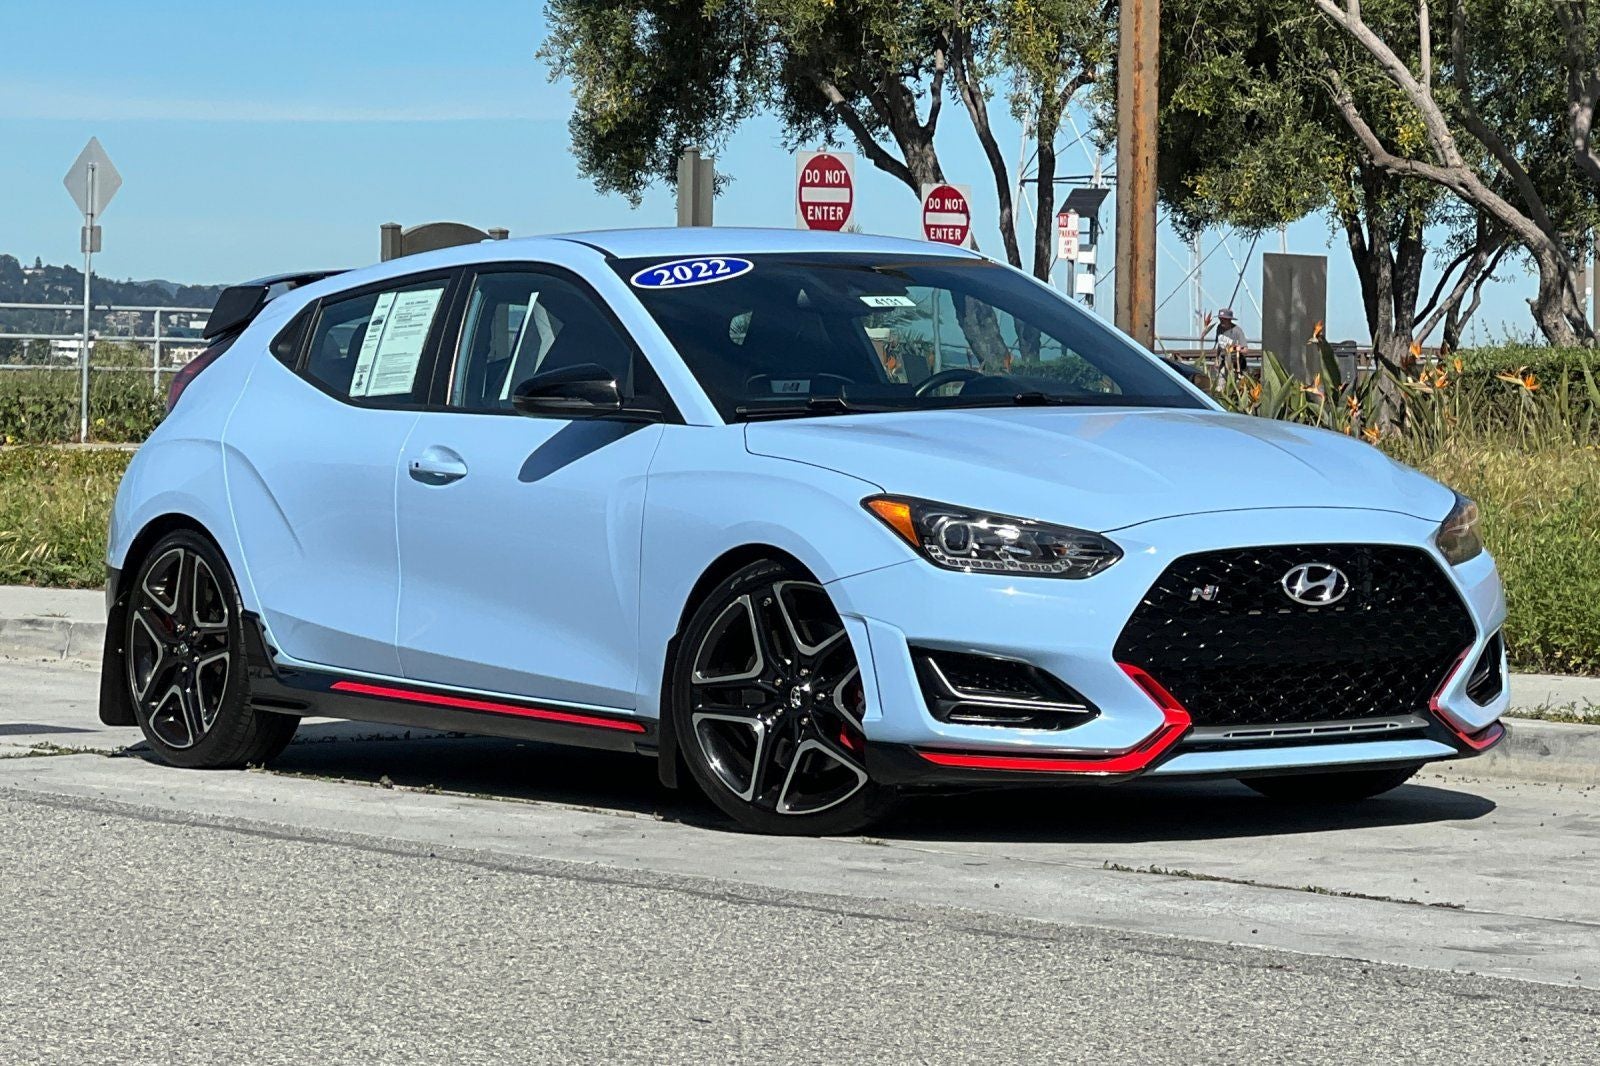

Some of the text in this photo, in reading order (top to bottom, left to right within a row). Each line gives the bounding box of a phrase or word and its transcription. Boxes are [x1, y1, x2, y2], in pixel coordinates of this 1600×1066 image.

[805, 169, 847, 184] DO NOT
[928, 198, 964, 211] DO NOT
[807, 206, 844, 221] ENTER
[1059, 215, 1068, 227] NO
[930, 227, 961, 240] ENTER
[1058, 230, 1078, 238] PARKING
[653, 259, 731, 286] 2022
[874, 298, 904, 306] 4131
